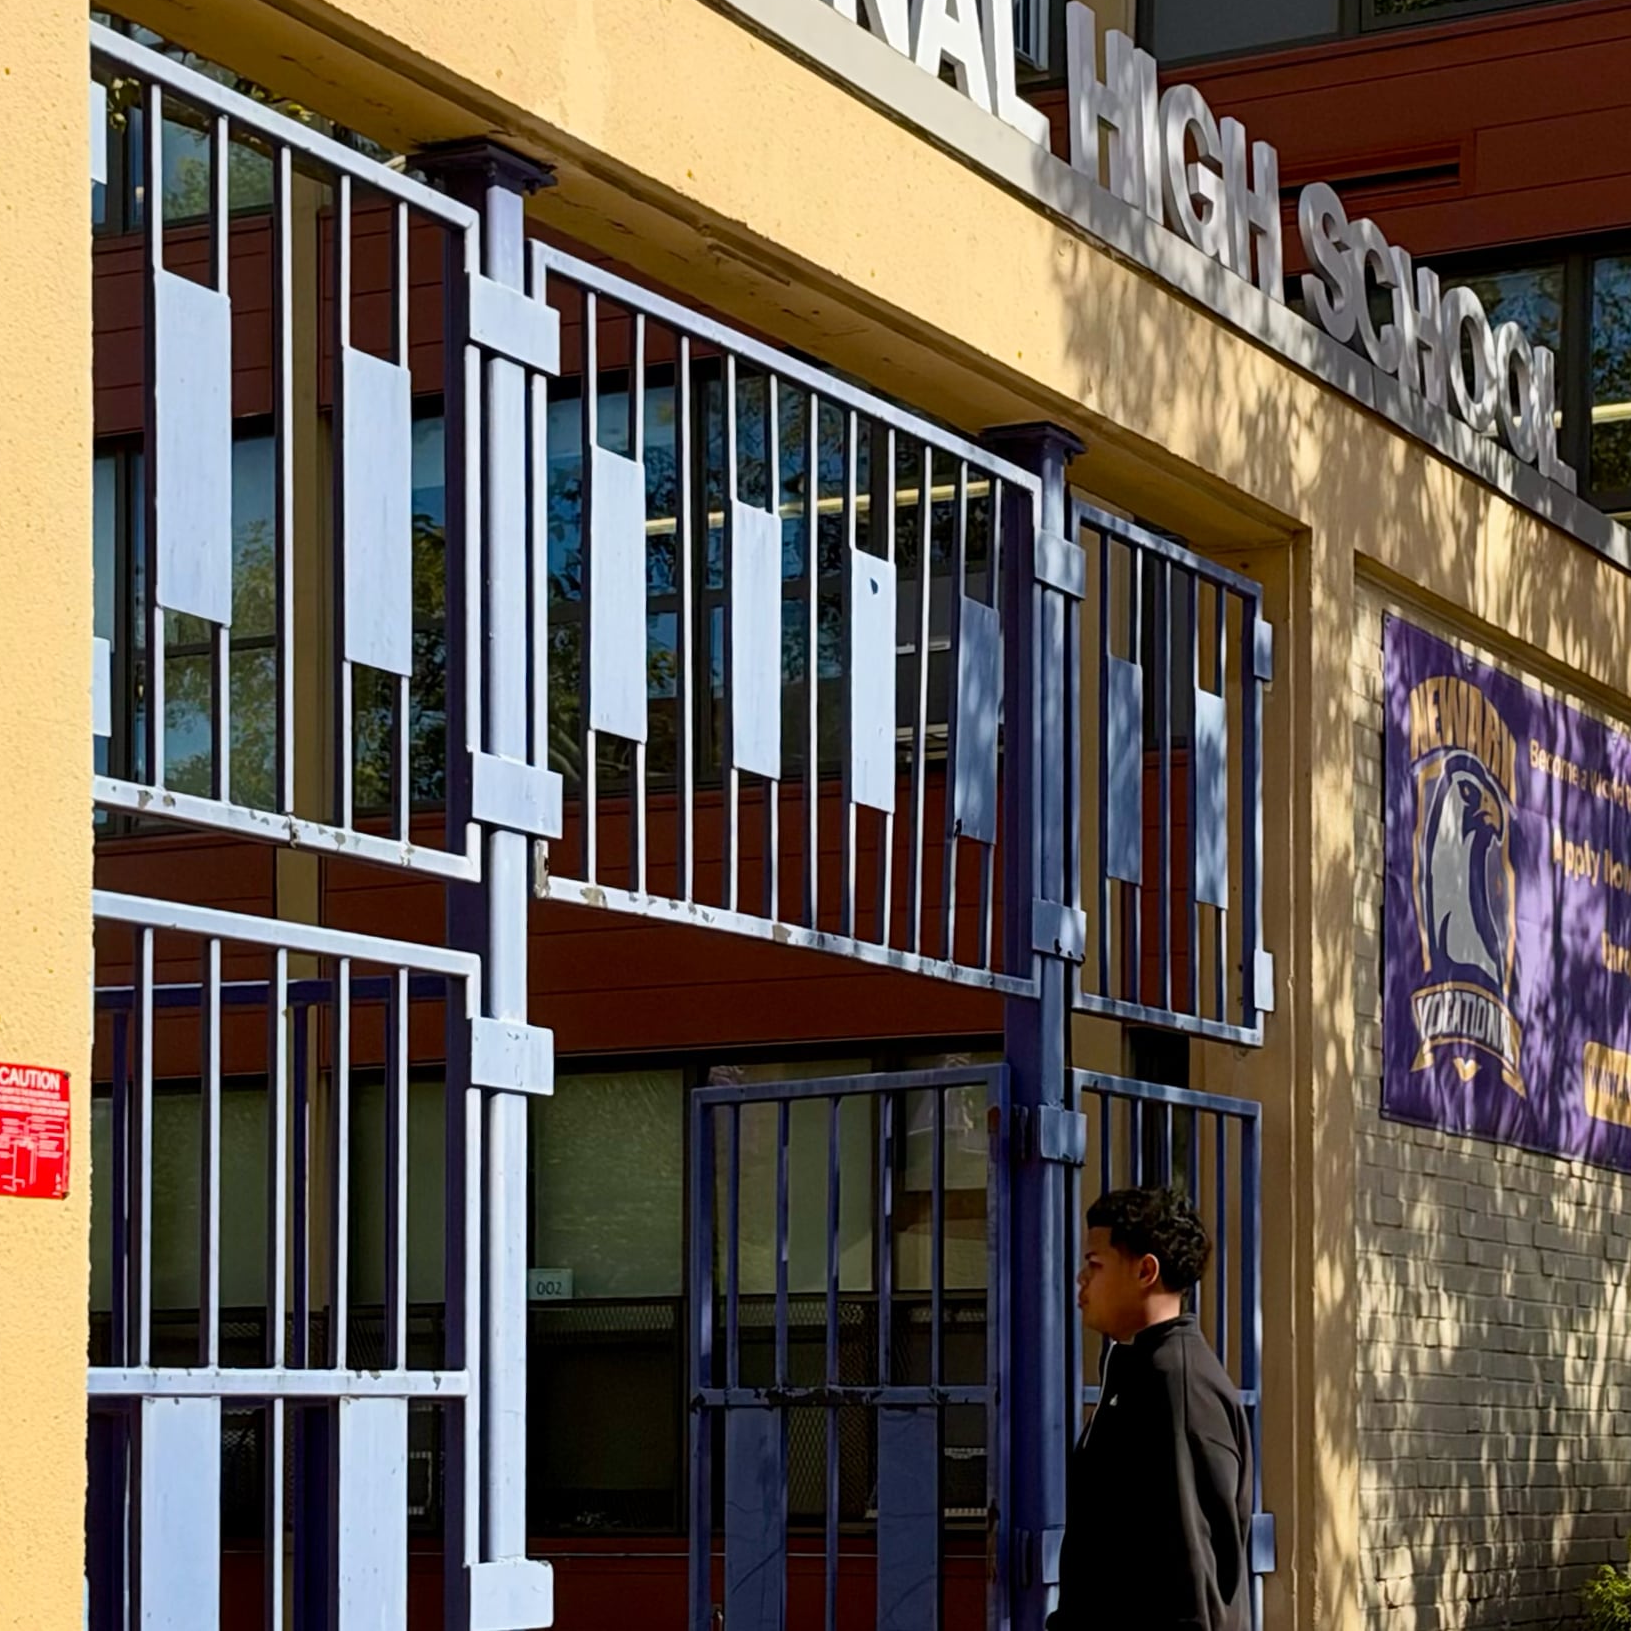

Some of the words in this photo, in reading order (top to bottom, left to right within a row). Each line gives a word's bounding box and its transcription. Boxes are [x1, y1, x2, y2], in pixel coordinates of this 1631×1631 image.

[1066, 0, 1285, 304] HIGH
[1298, 182, 1577, 495] SCHOOL
[1410, 675, 1517, 807] NEWARK
[1530, 738, 1579, 787] Become
[1553, 829, 1601, 887] Apply
[1416, 990, 1515, 1065] VOCATIONAL
[536, 1281, 562, 1296] 002
